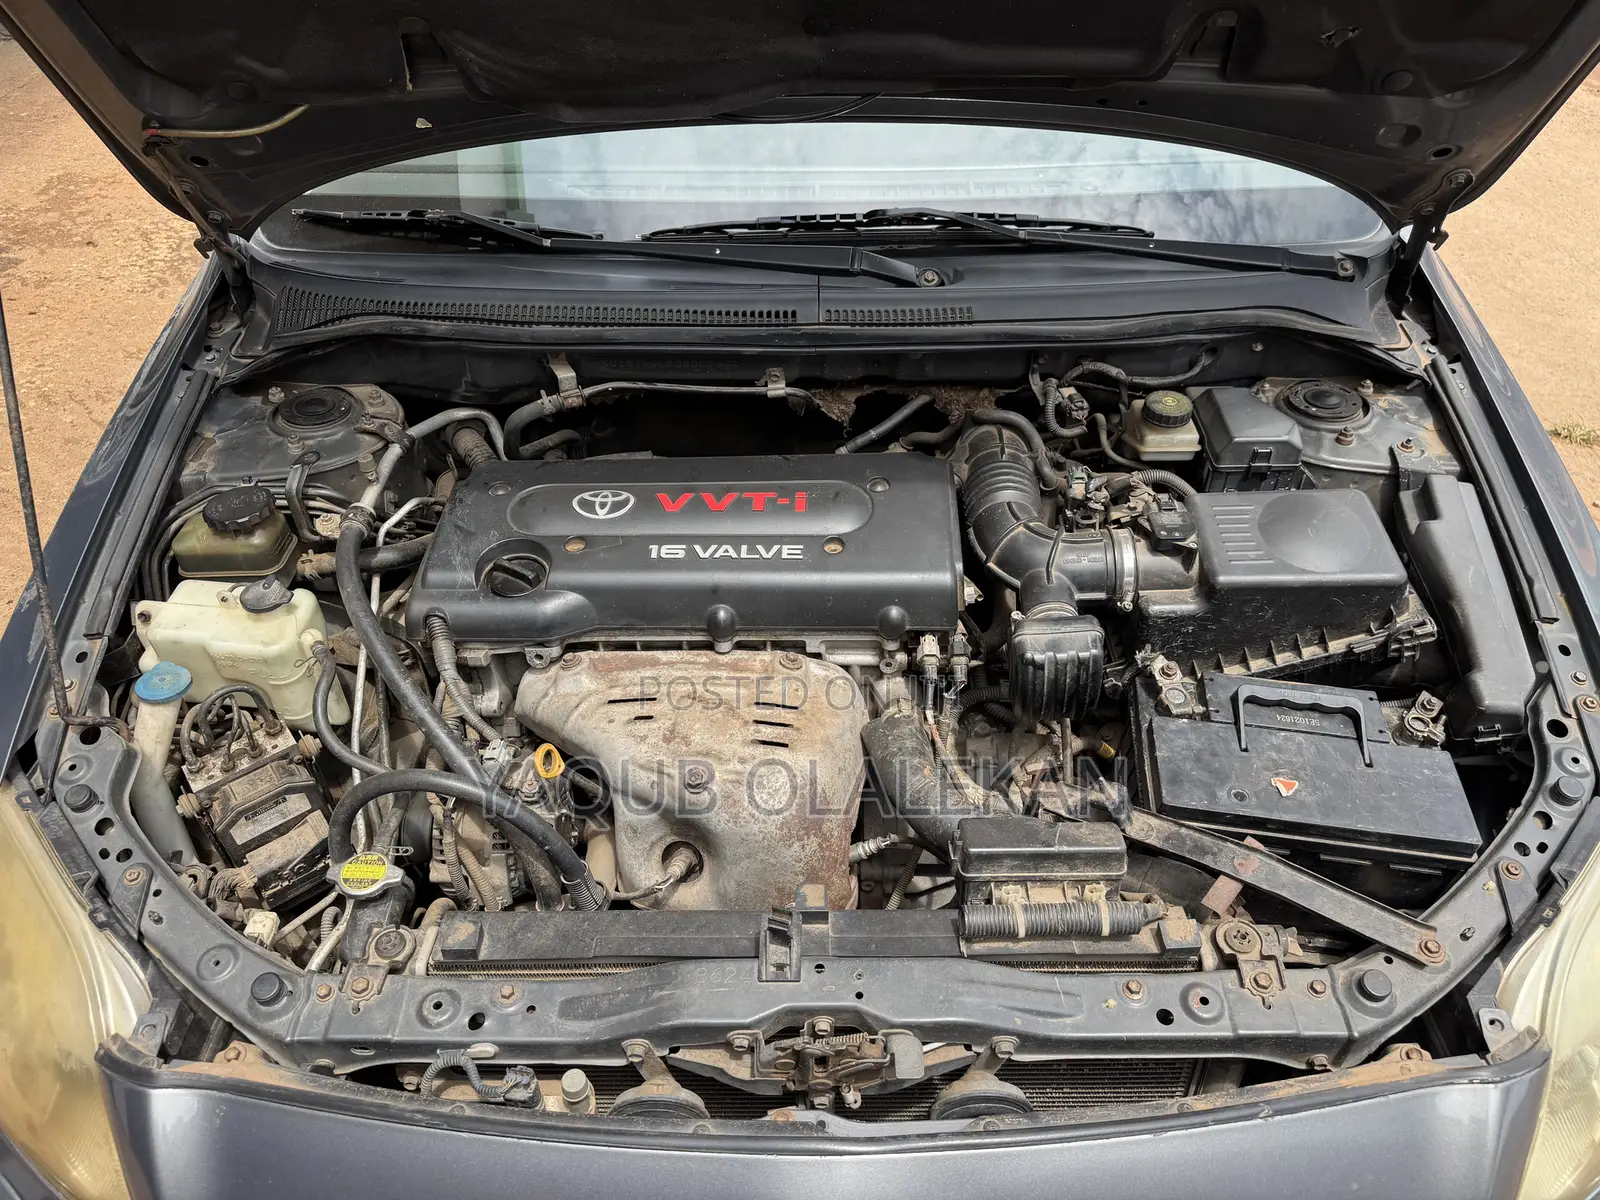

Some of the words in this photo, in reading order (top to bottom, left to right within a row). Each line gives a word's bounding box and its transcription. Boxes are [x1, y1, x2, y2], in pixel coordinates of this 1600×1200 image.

[655, 492, 808, 513] VVT-i
[648, 544, 687, 560] 16
[691, 544, 805, 560] VALVE
